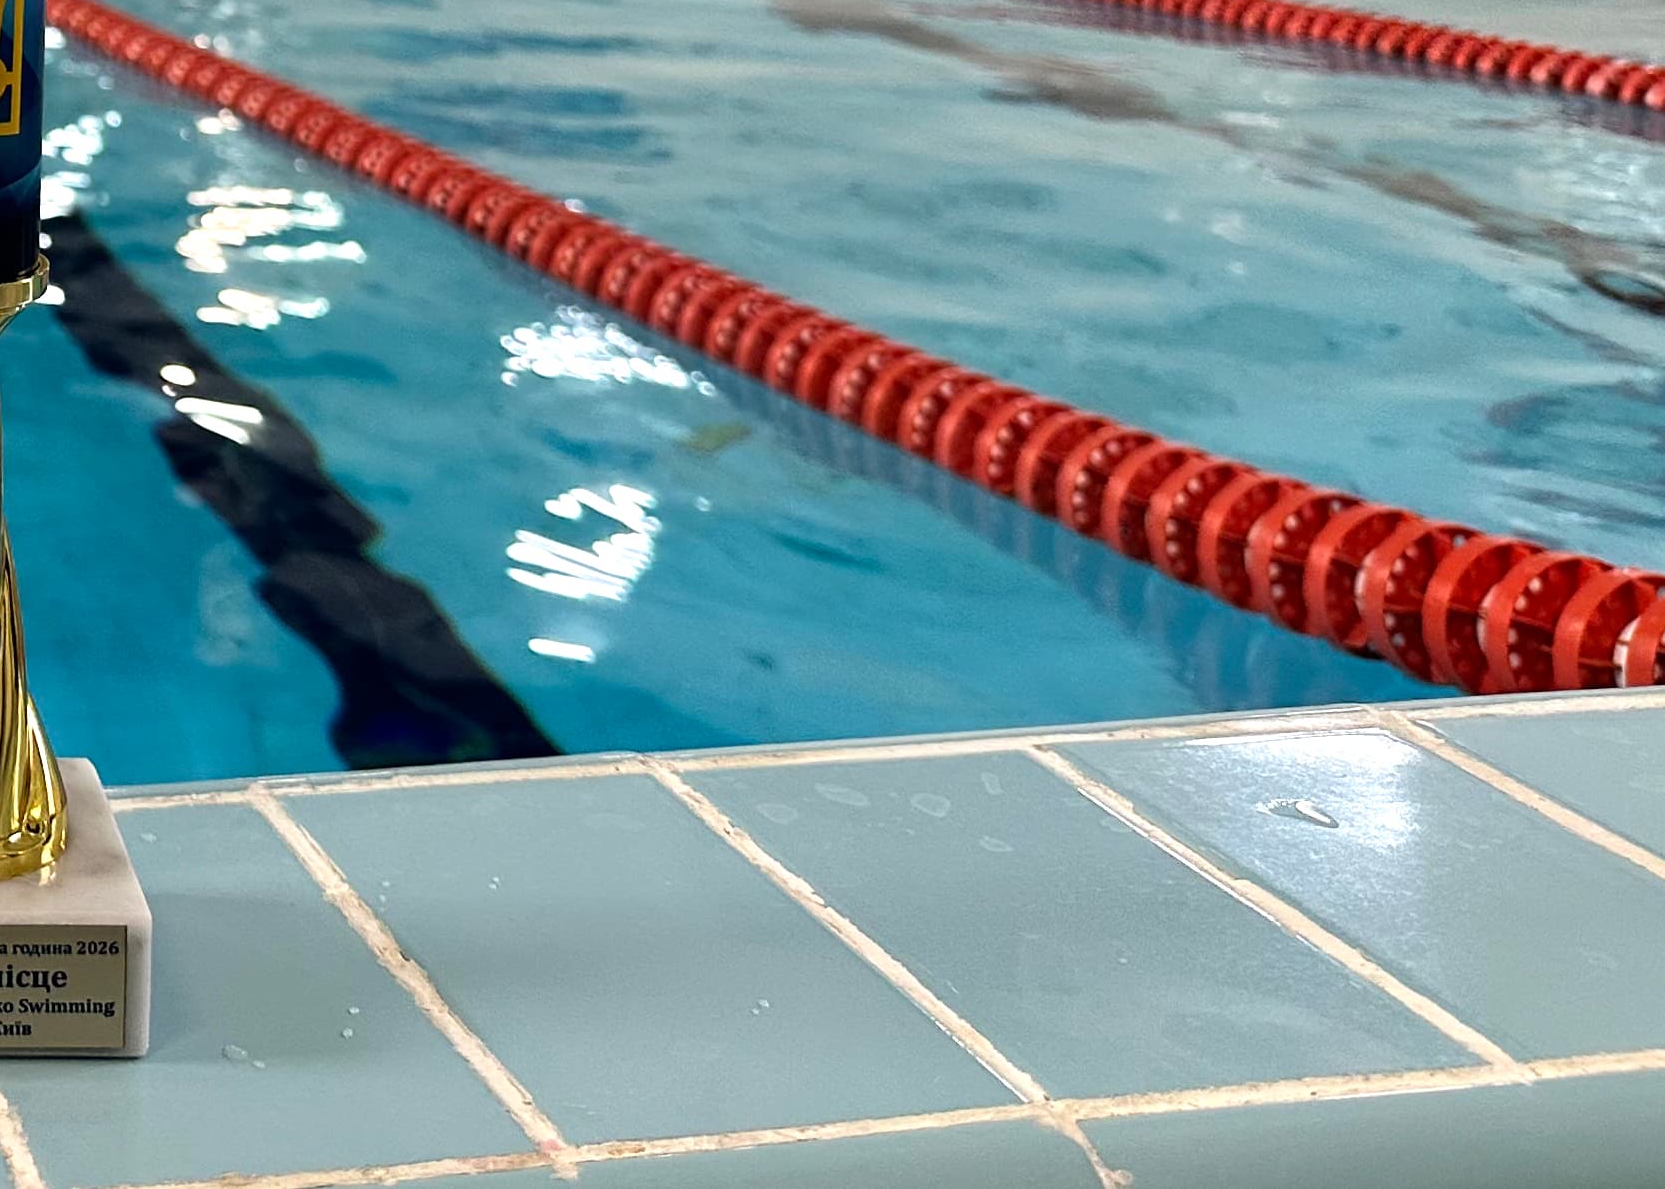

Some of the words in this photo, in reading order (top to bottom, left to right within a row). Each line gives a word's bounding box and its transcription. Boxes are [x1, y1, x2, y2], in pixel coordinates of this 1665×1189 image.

[12, 943, 73, 957] година
[76, 941, 120, 955] 2026
[18, 998, 115, 1017] Swimming
